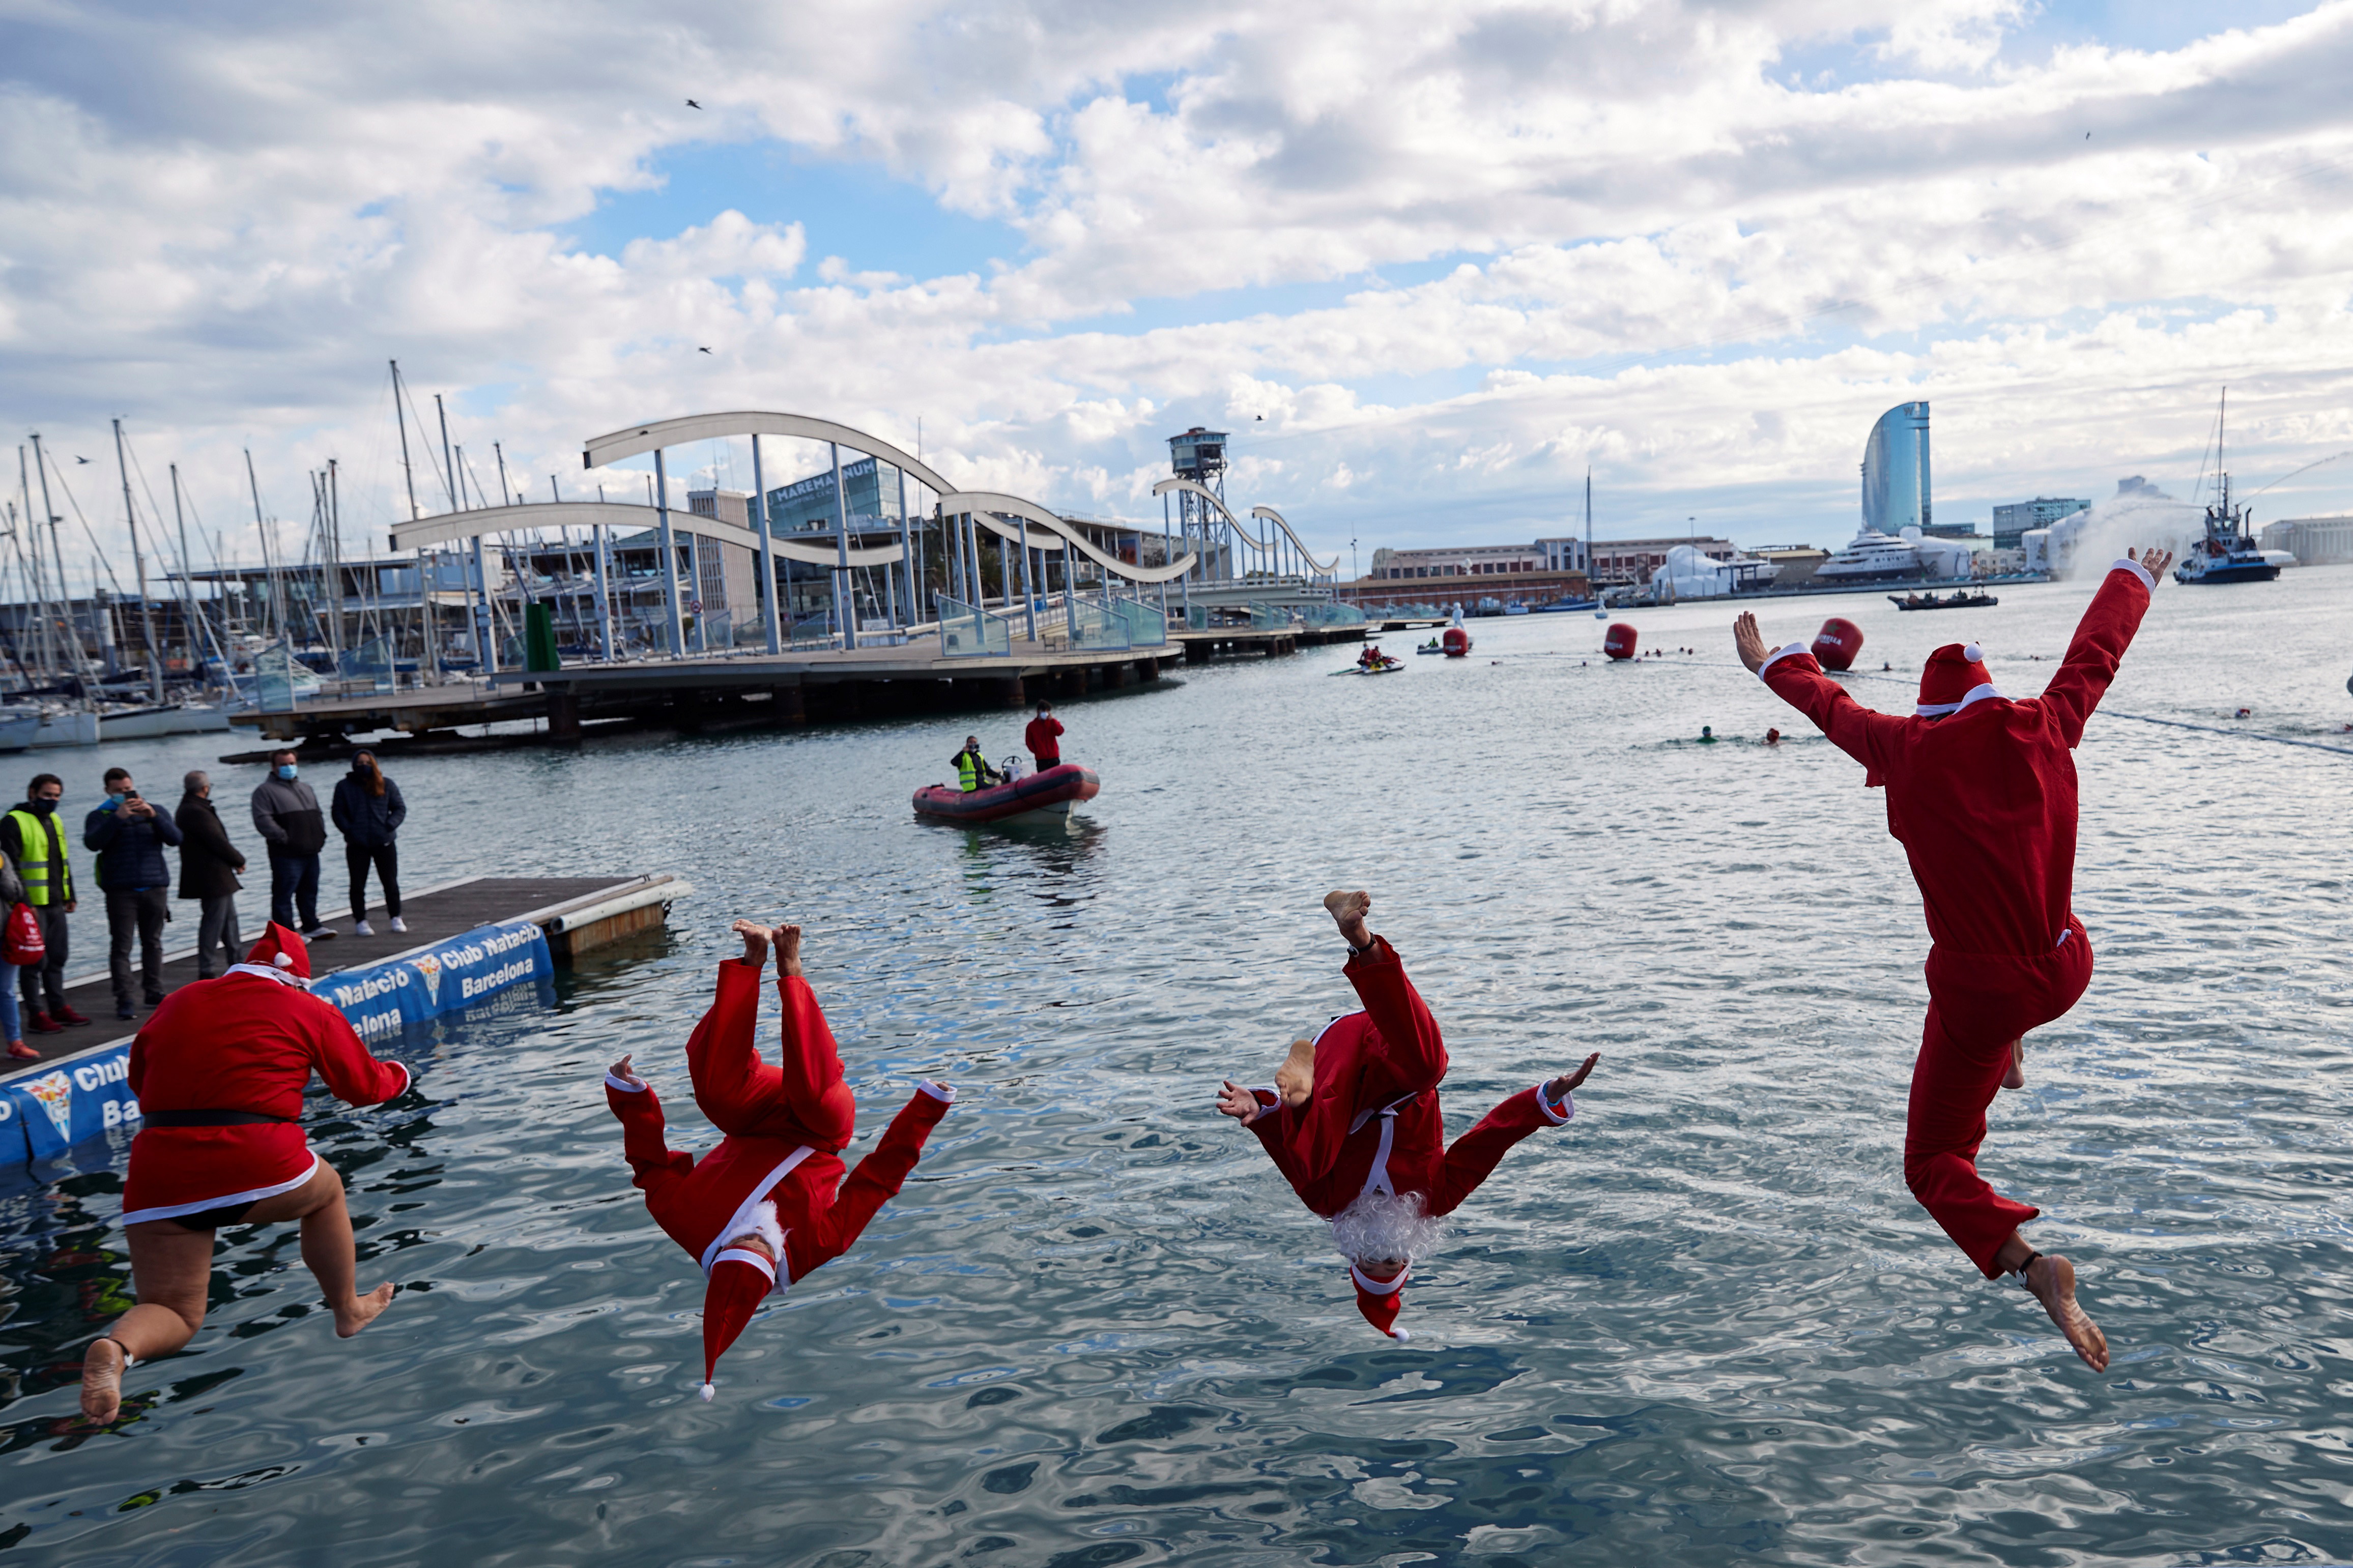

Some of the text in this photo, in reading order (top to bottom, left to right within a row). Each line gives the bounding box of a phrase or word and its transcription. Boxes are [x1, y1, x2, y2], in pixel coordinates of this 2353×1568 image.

[776, 460, 875, 502] MAREMANUM
[441, 923, 541, 970] Club Natació
[334, 968, 409, 1008] Natació
[462, 958, 533, 999] Barcelona
[352, 1008, 402, 1037] elona
